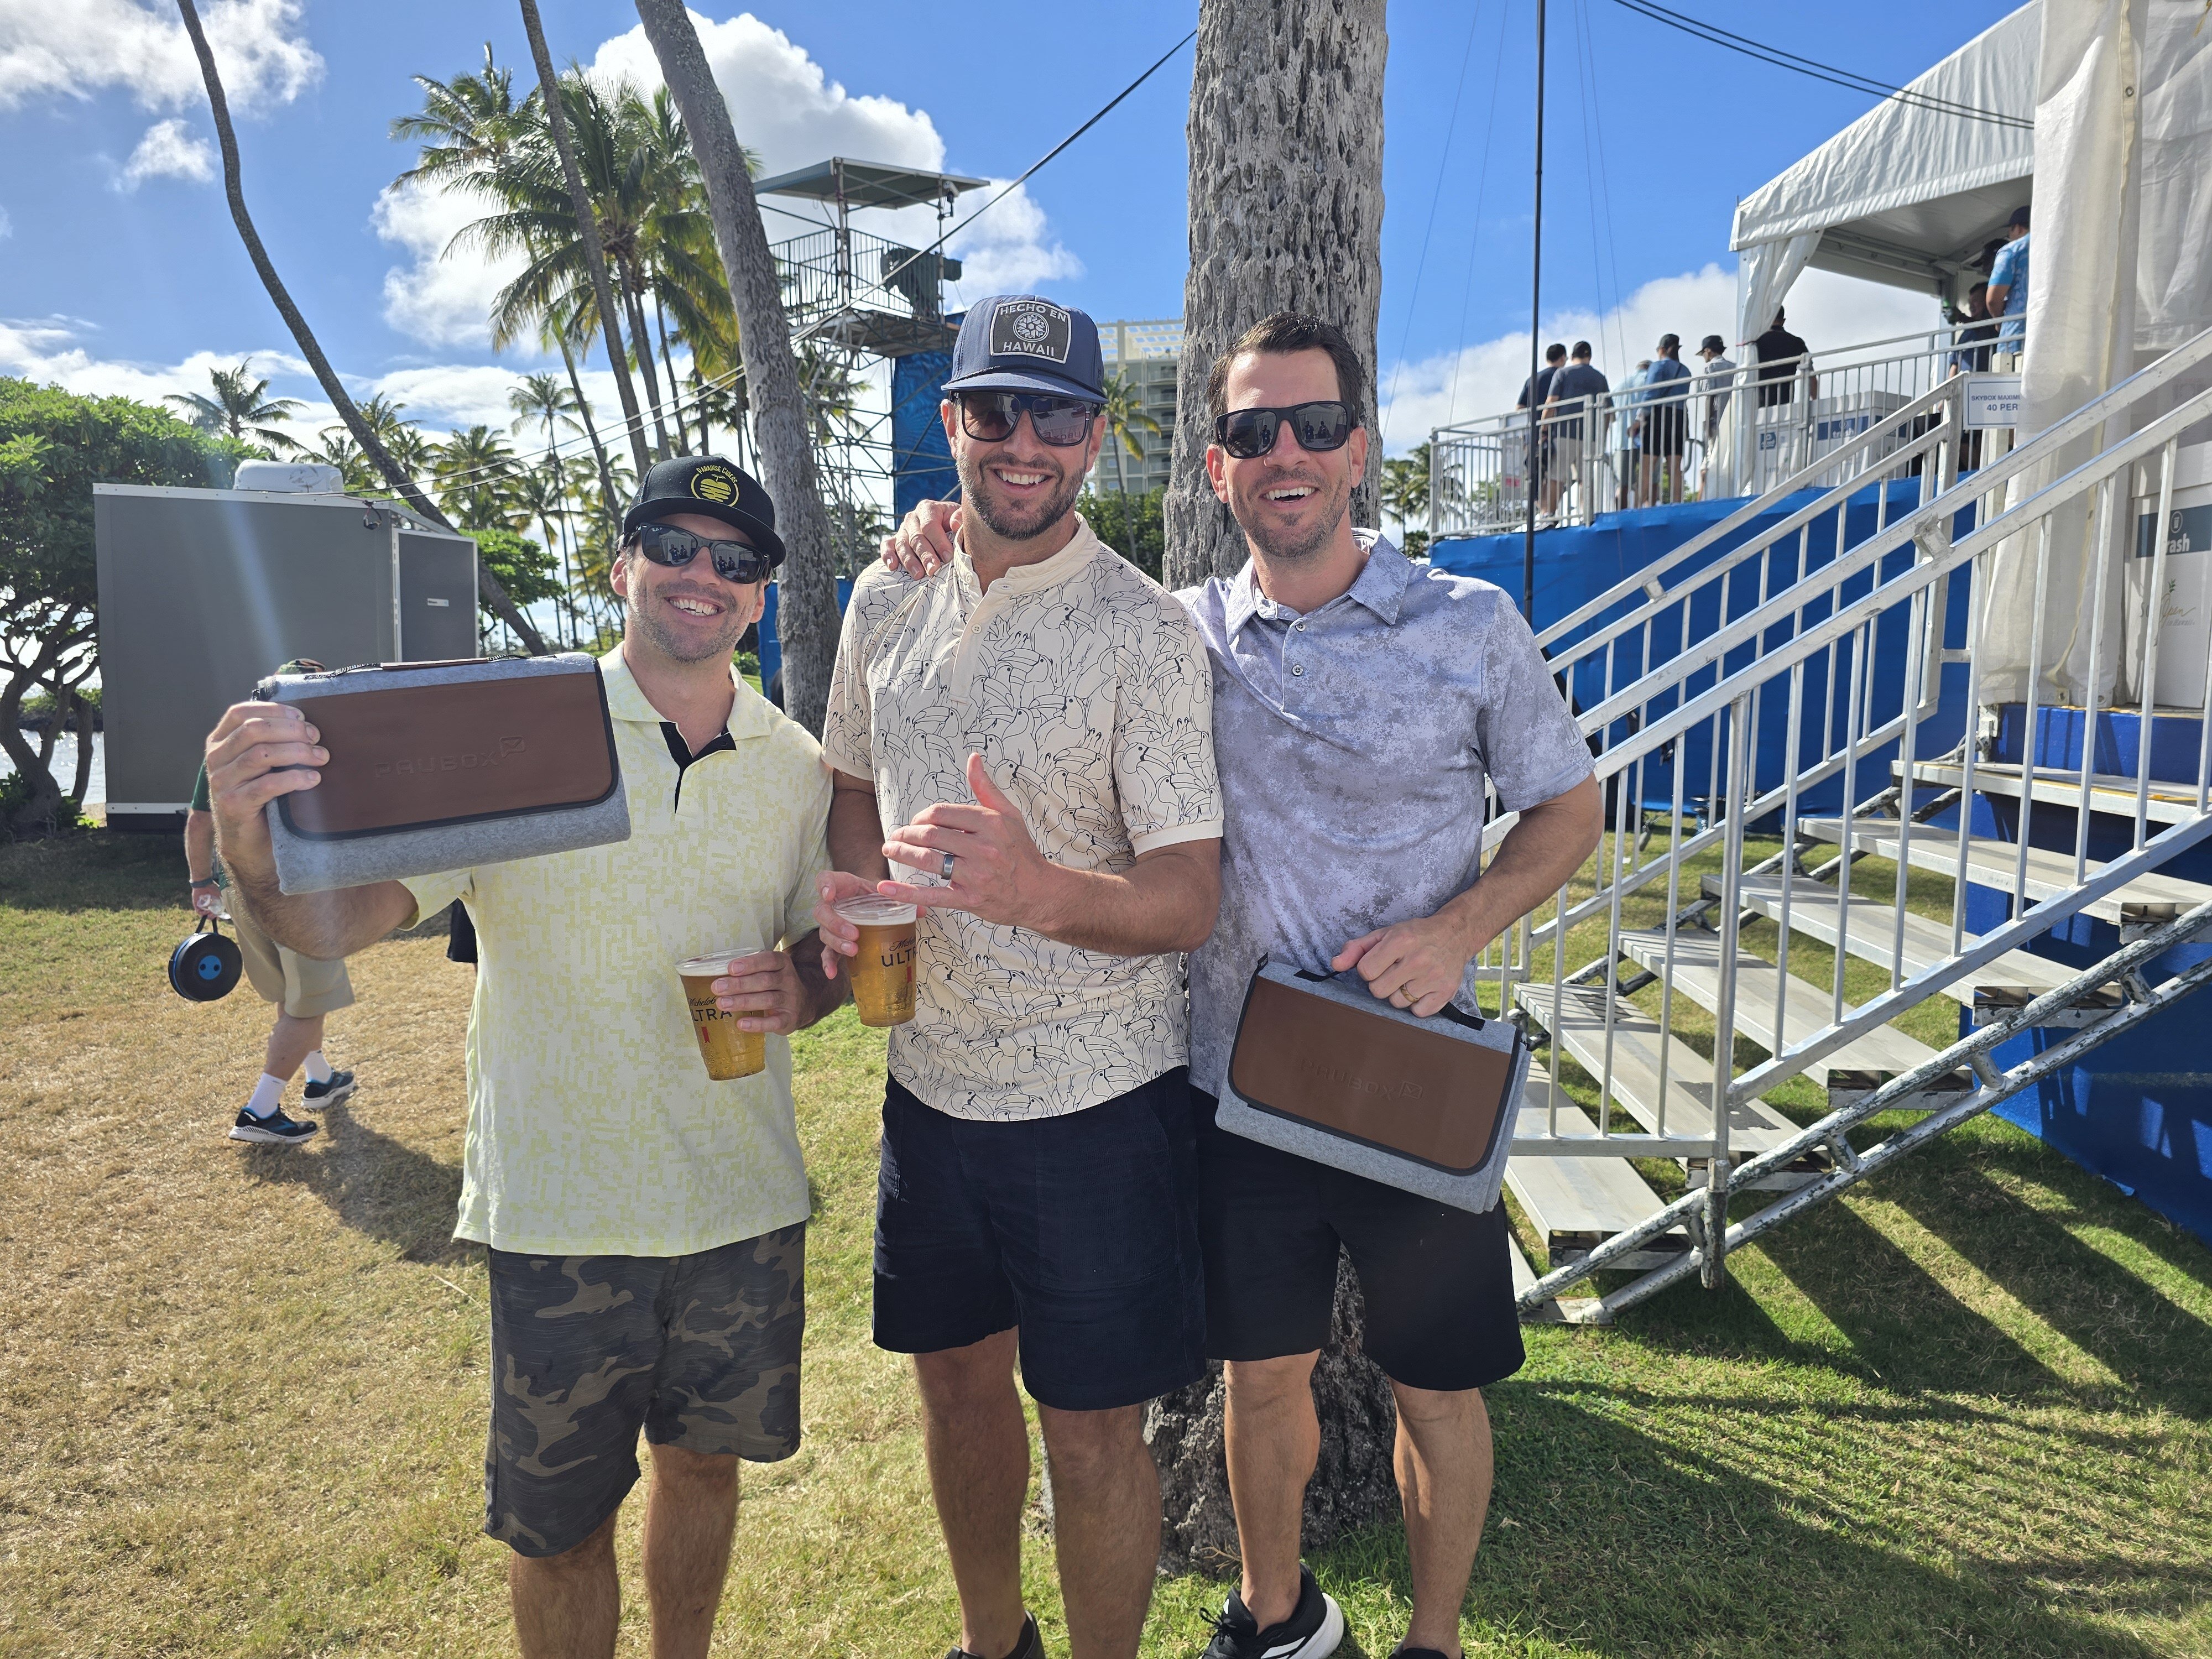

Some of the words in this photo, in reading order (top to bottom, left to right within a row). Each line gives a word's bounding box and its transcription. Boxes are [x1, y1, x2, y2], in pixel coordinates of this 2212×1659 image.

[1000, 304, 1046, 315] HECHO
[1050, 310, 1066, 322] EN
[1003, 341, 1055, 357] HAWAII
[2166, 533, 2190, 554] rash
[373, 750, 499, 779] PAUBOX
[691, 1008, 733, 1022] LTRA
[1300, 1058, 1396, 1100] PAUBOX
